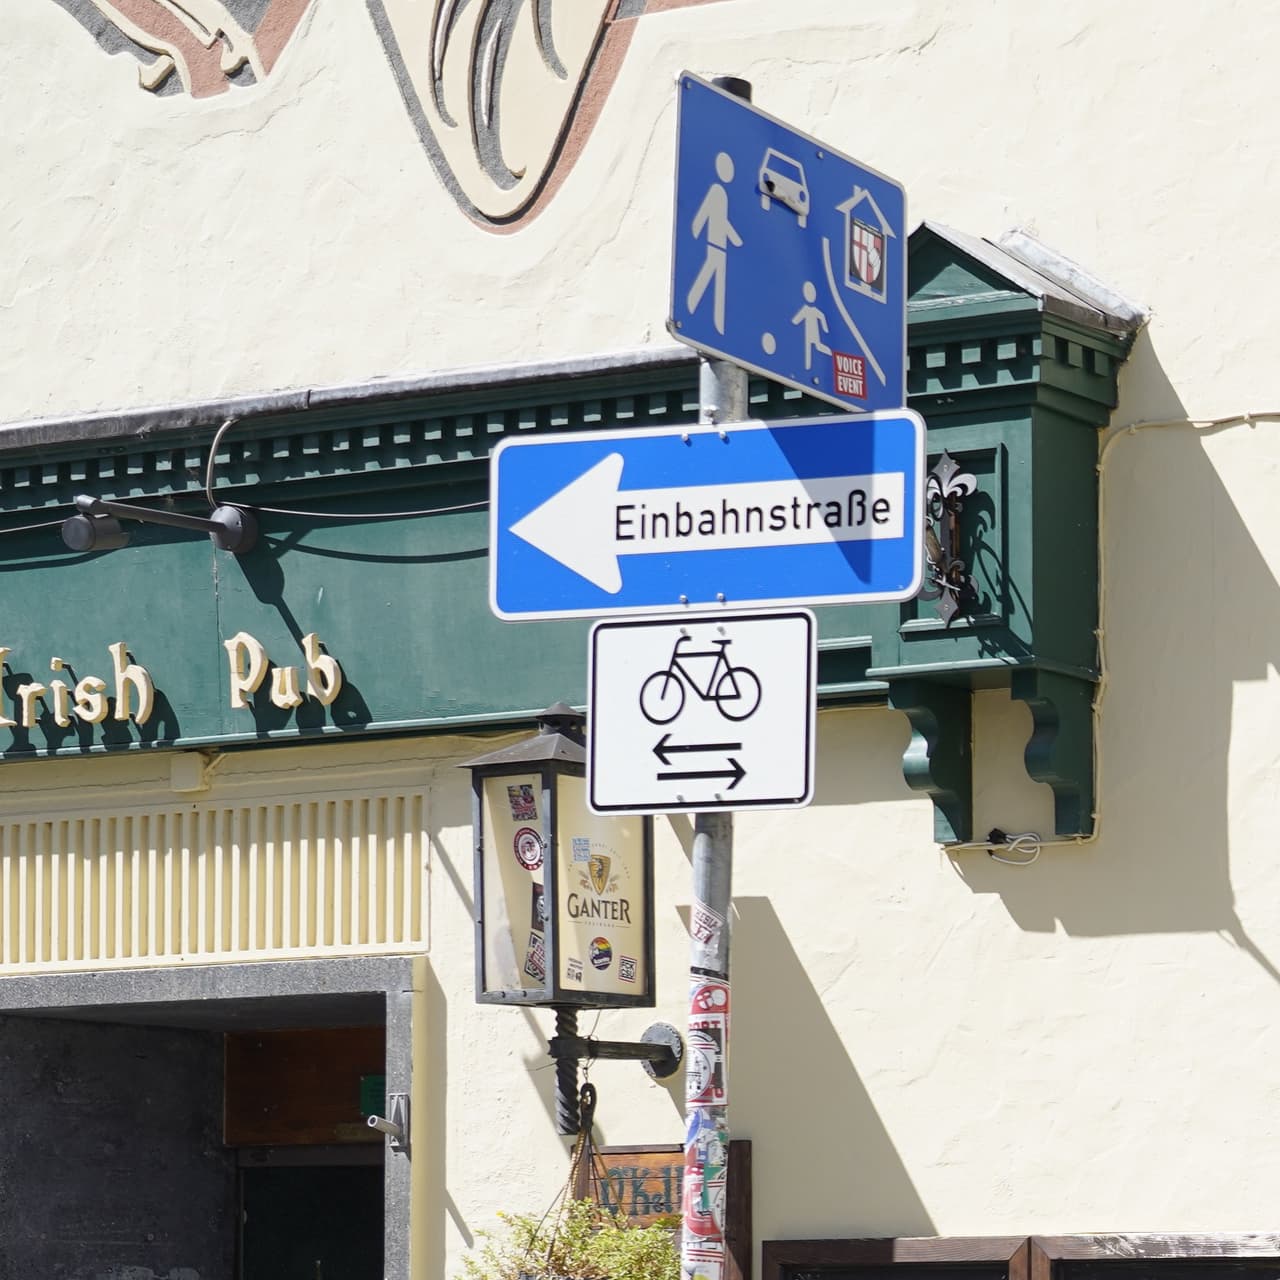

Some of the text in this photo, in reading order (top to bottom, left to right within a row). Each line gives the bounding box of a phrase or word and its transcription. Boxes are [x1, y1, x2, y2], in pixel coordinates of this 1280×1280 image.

[836, 354, 863, 375] VOICE
[837, 376, 864, 396] EVENT
[616, 489, 891, 541] Einbahnstraße
[223, 631, 342, 709] Pub
[568, 893, 632, 924] GANTER
